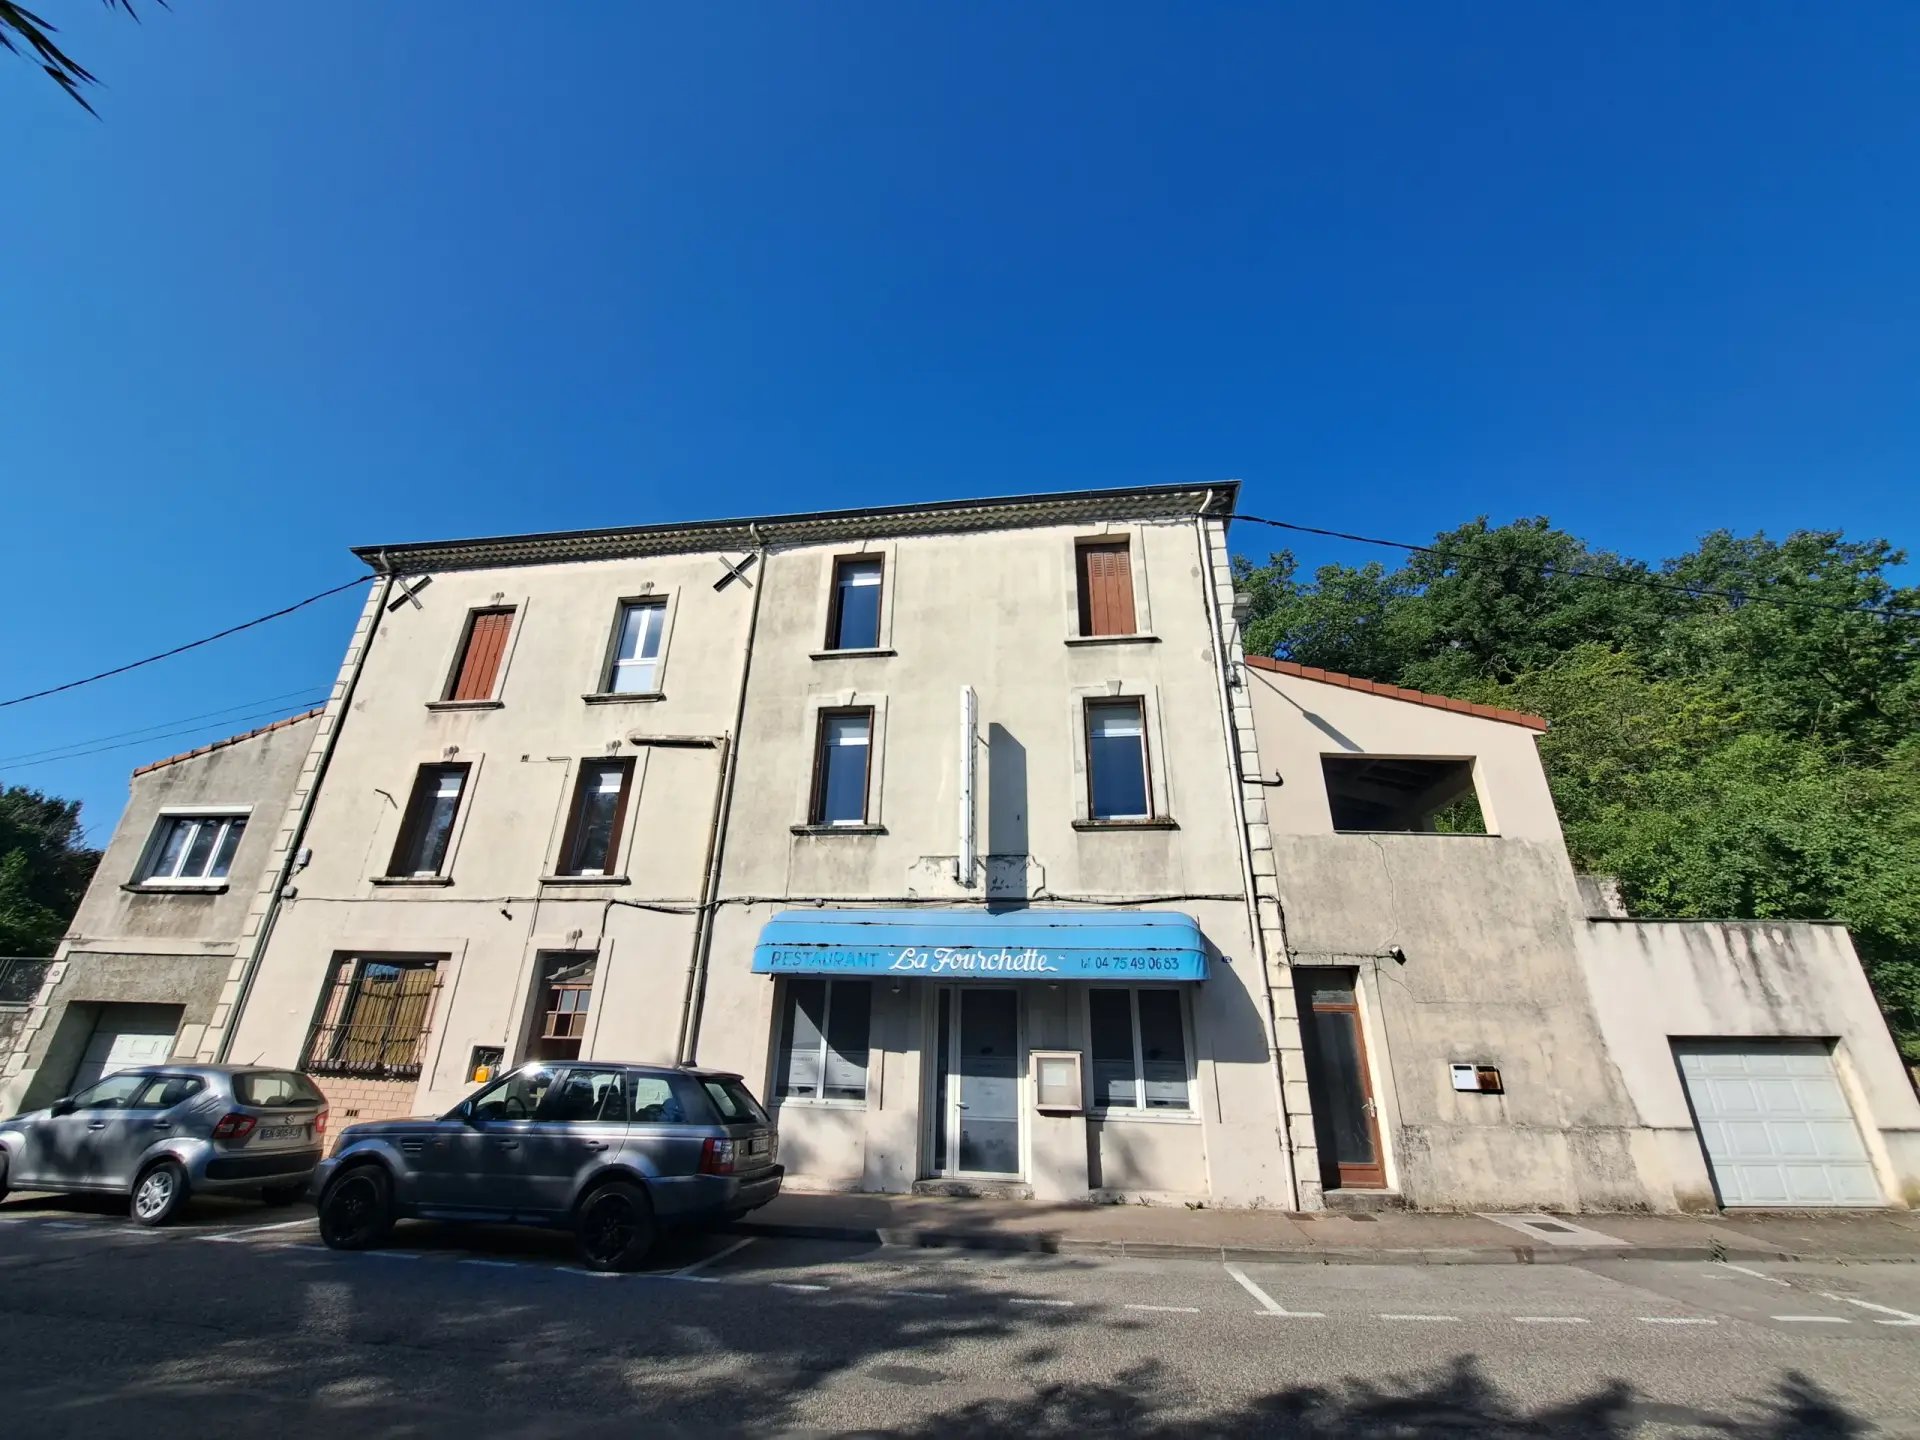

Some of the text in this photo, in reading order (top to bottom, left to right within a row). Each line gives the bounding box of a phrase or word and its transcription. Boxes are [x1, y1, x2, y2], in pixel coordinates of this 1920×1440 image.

[1095, 957, 1109, 969] 04
[1112, 957, 1128, 970] 75
[1130, 957, 1145, 970] 49
